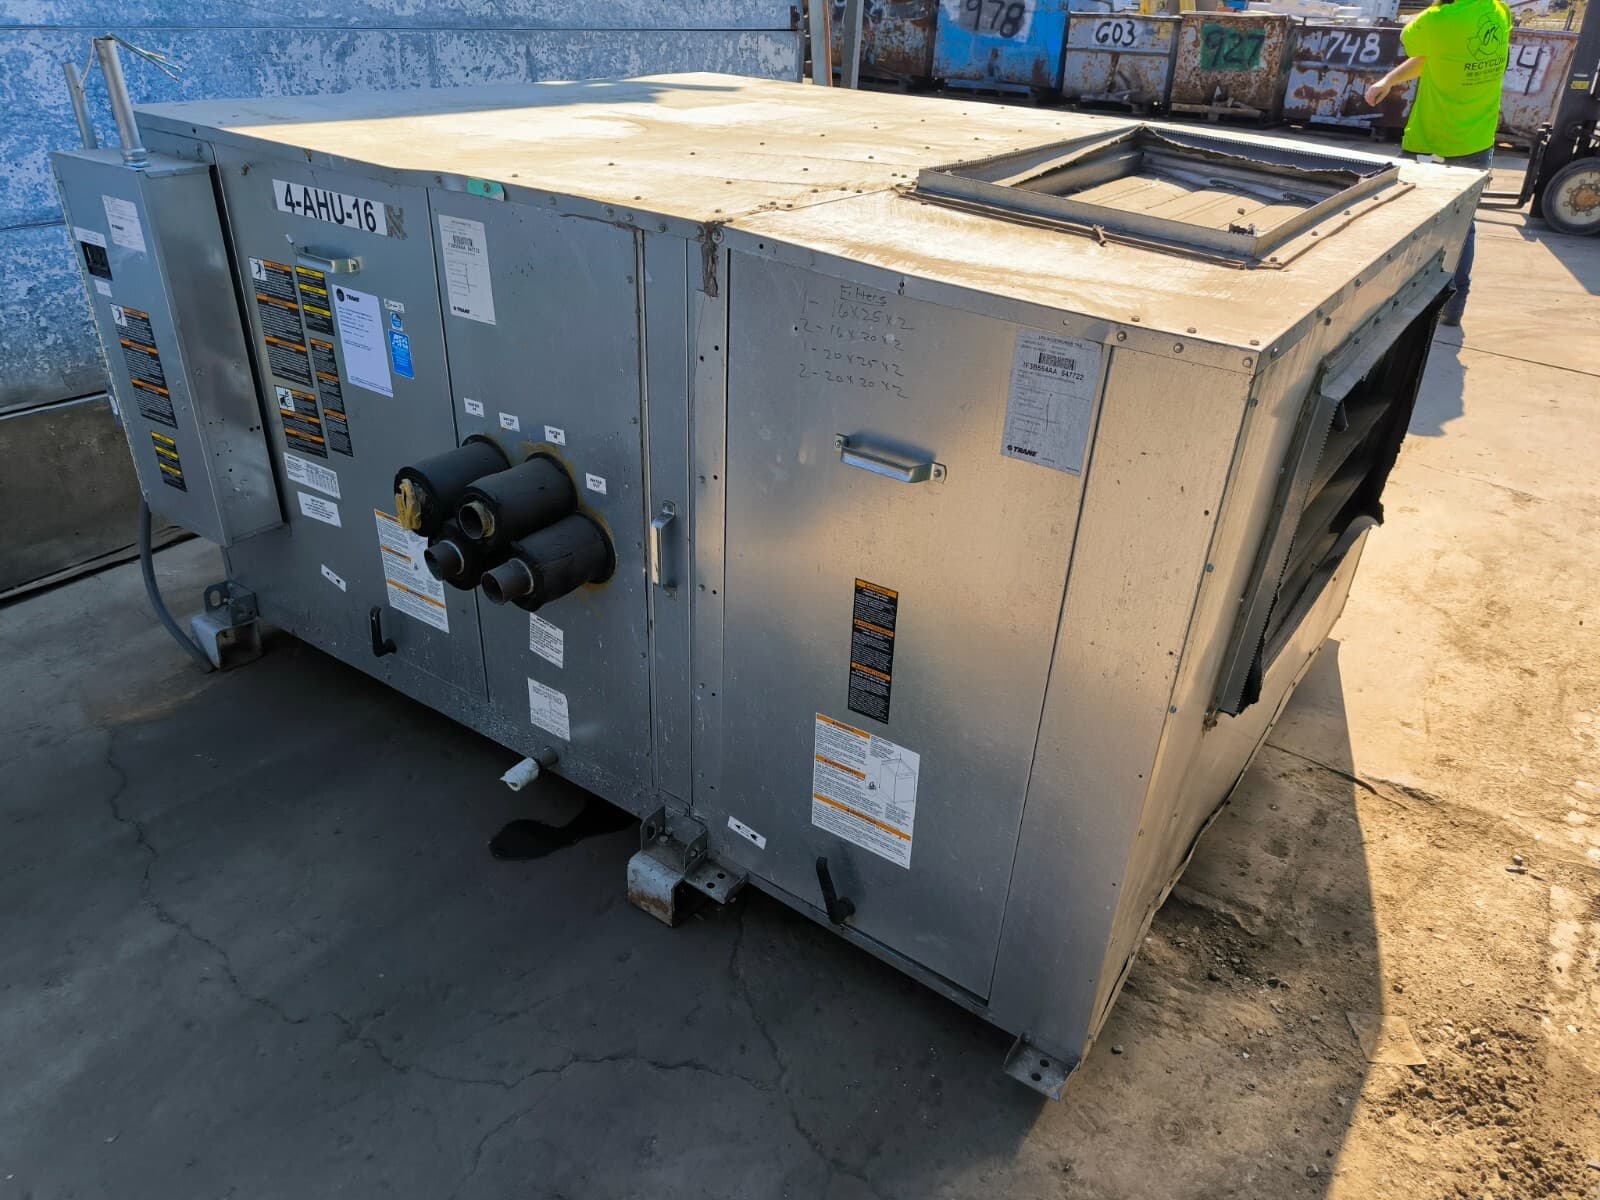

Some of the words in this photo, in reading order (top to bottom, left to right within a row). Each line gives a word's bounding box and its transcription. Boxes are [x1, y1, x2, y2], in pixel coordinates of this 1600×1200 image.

[966, 0, 1025, 38] 978
[1095, 20, 1136, 47] 603
[1205, 29, 1266, 68] 927
[1326, 31, 1380, 66] 748
[284, 183, 377, 233] 4-AHU-16
[840, 284, 888, 301] Filters
[1013, 446, 1038, 457] TRANE
